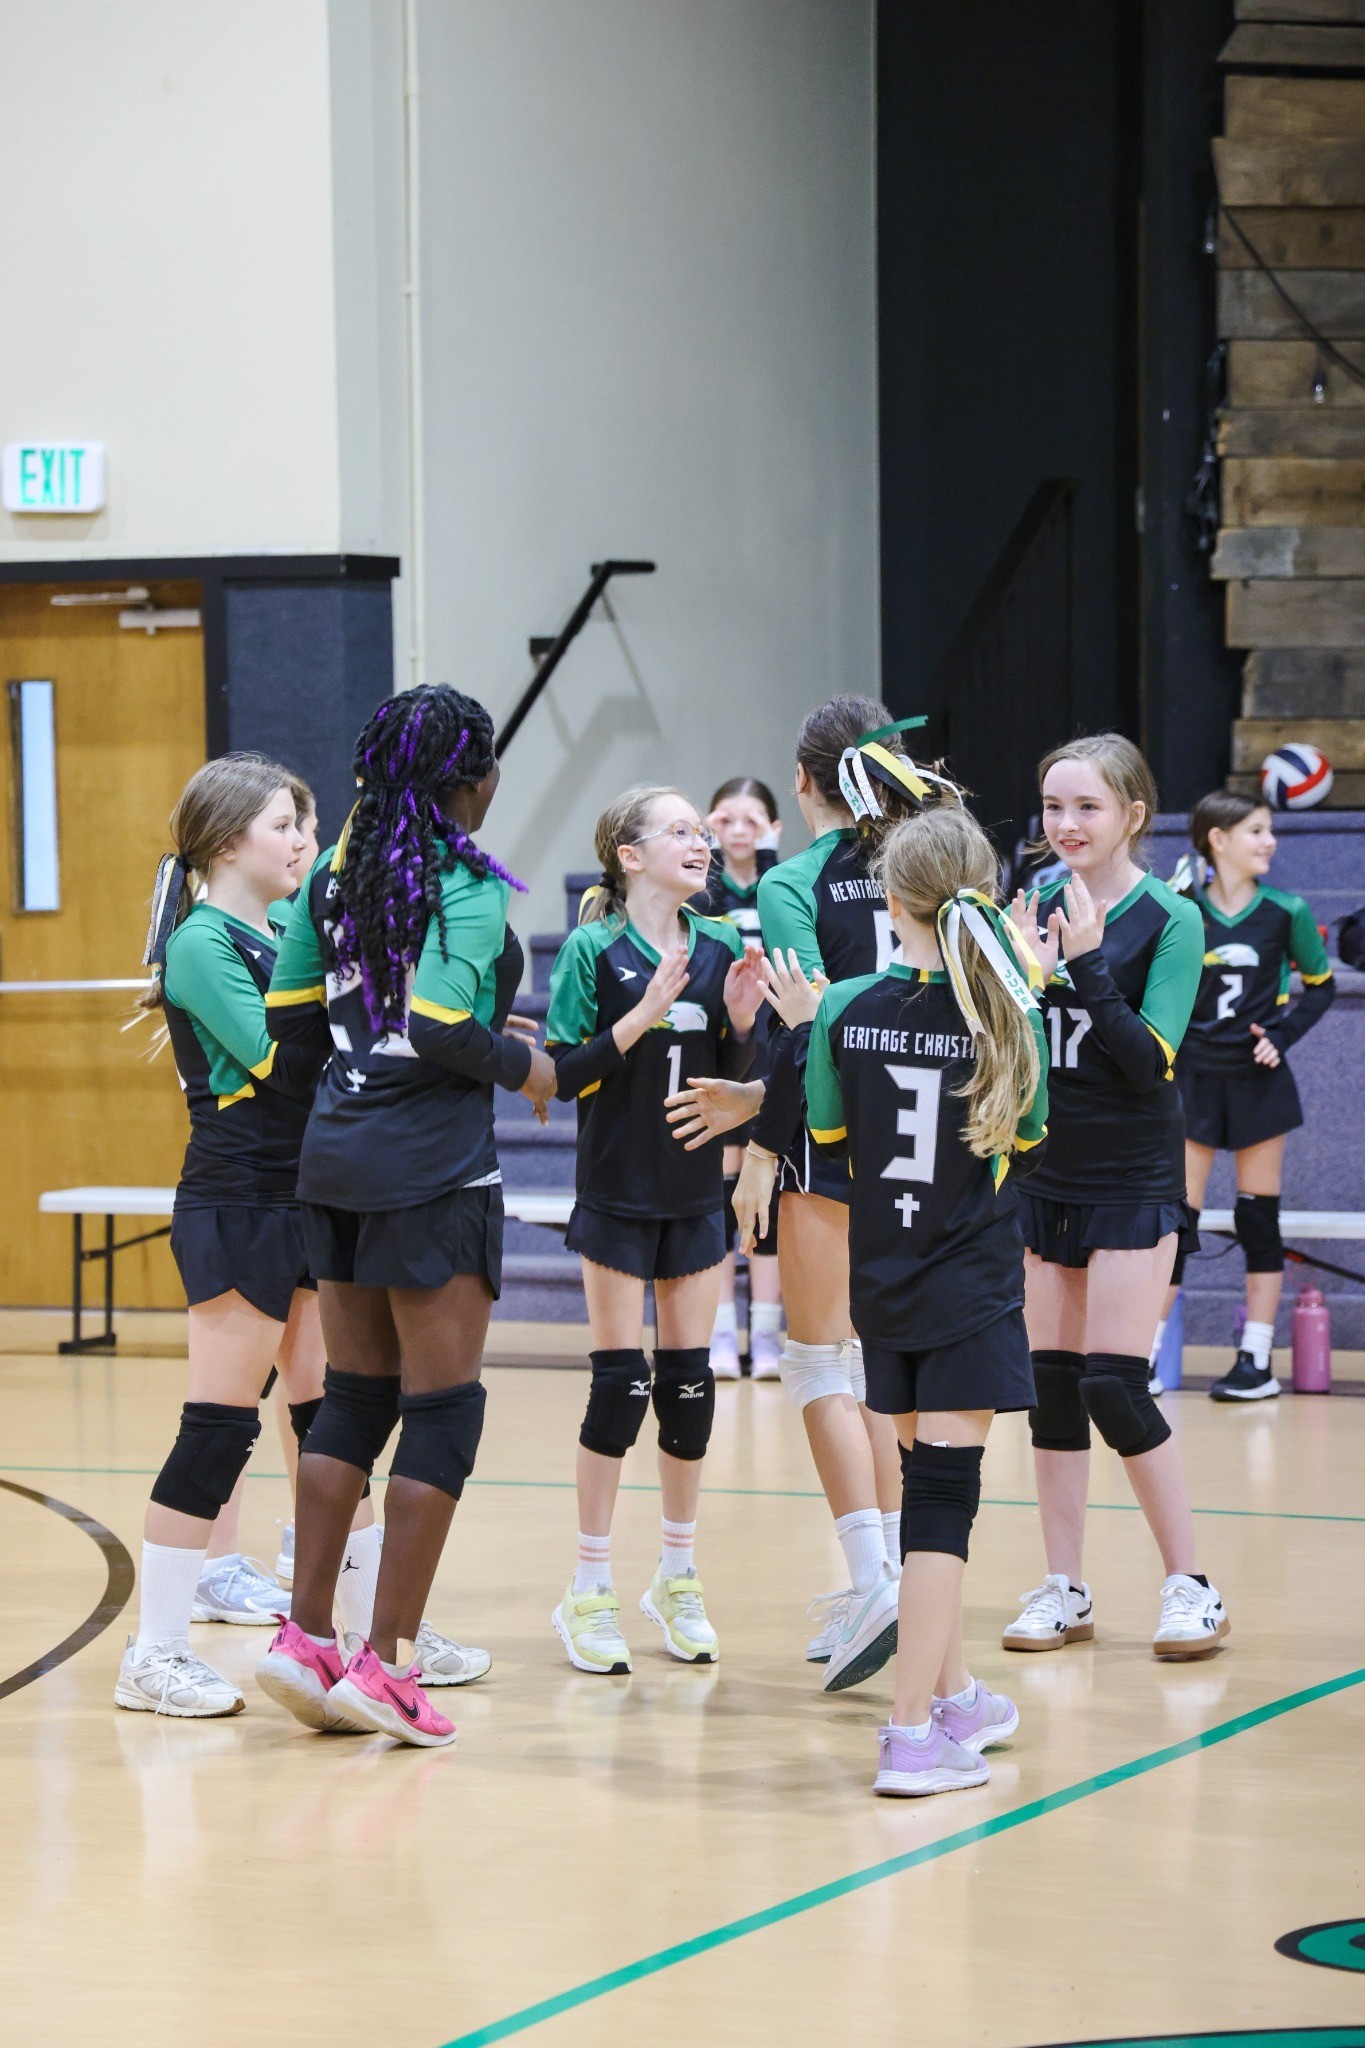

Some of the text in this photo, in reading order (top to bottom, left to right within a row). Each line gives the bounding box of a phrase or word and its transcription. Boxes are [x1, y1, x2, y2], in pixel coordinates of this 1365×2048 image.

[19, 448, 85, 505] EXIT
[1217, 973, 1243, 1020] 2
[1046, 1006, 1093, 1069] 17
[666, 1044, 682, 1099] 1
[880, 1063, 942, 1184] 3
